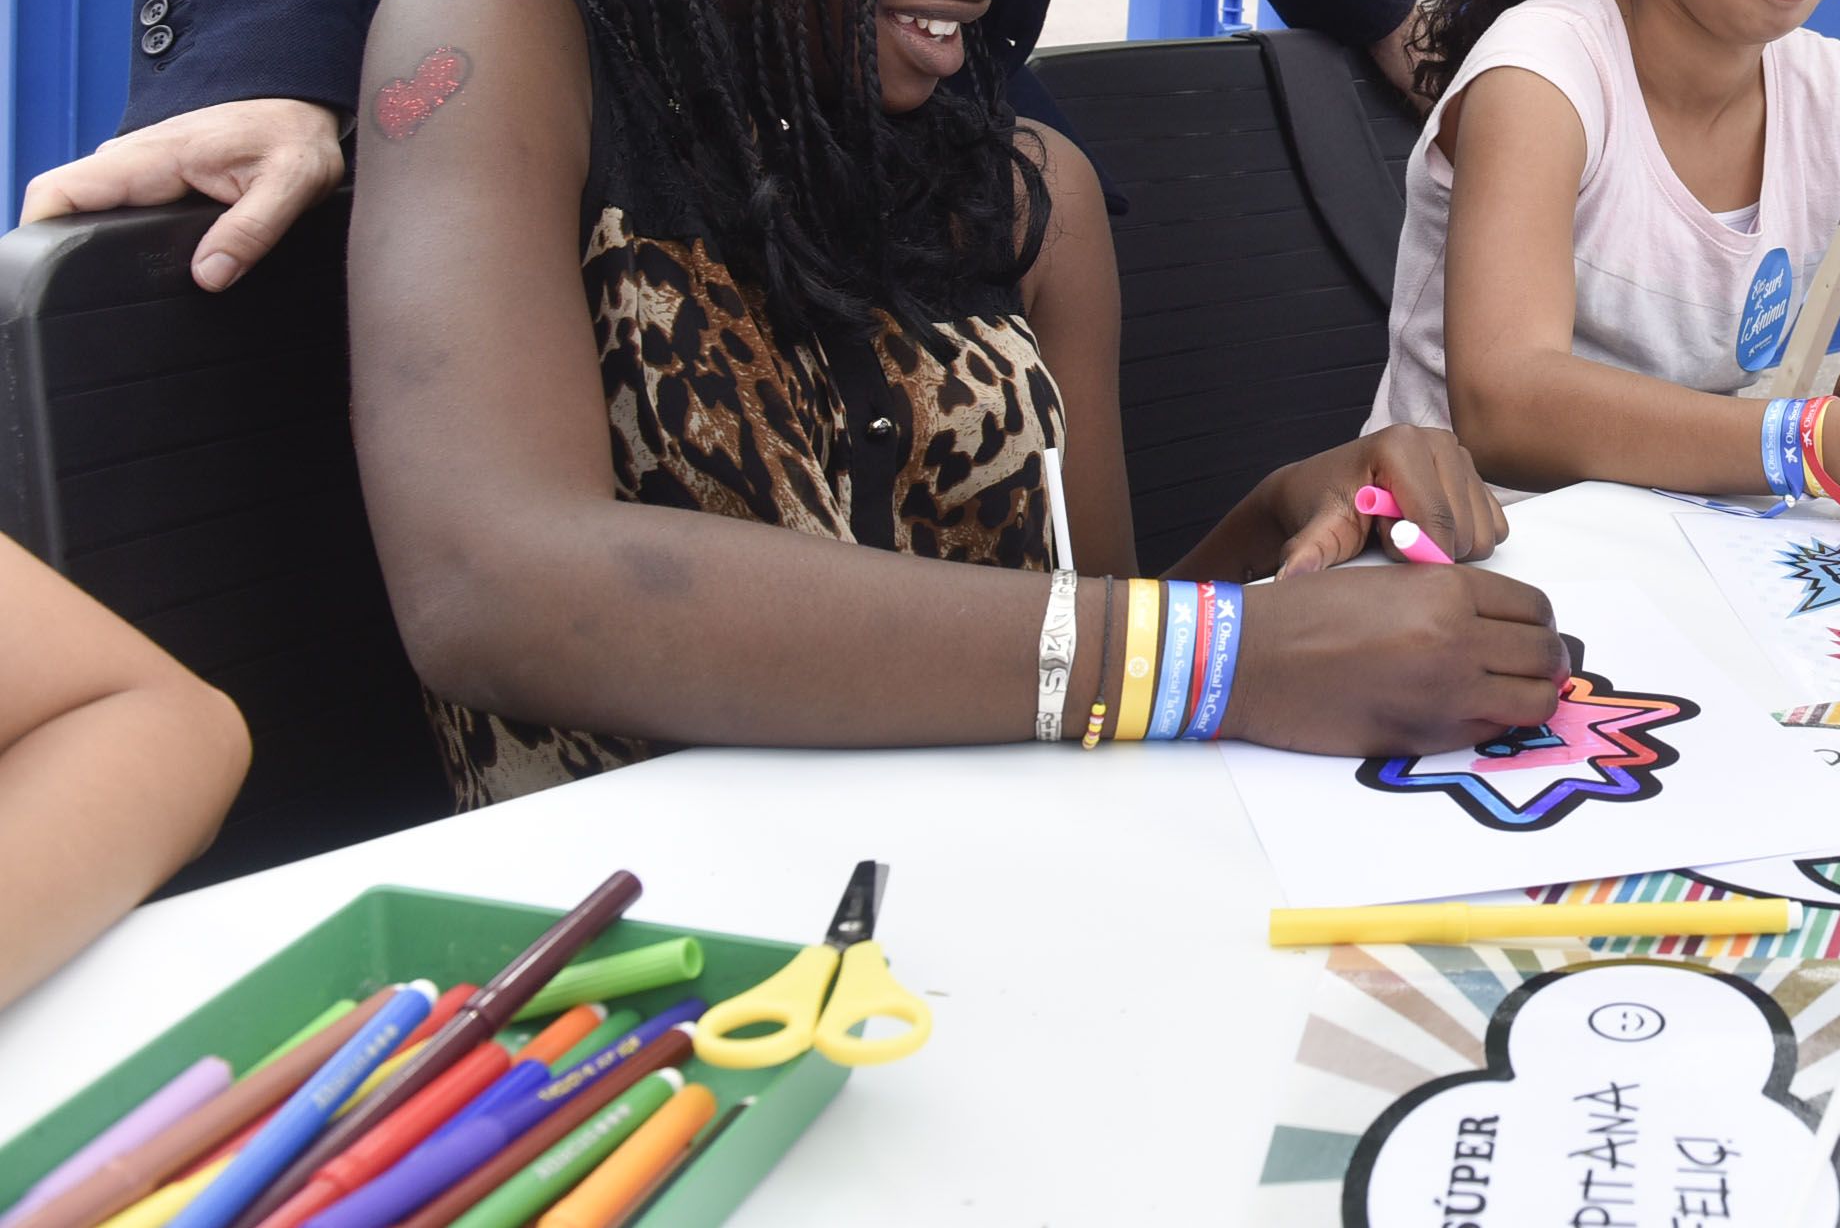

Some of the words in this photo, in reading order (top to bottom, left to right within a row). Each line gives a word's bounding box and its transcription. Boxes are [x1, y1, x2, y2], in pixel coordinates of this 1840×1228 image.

[1785, 422, 1795, 445] Obra
[1174, 627, 1189, 660] Obra
[1217, 621, 1233, 651] Obra
[1169, 660, 1185, 691] Social
[1211, 651, 1228, 689] Social
[1433, 1113, 1500, 1228] ÚPER
